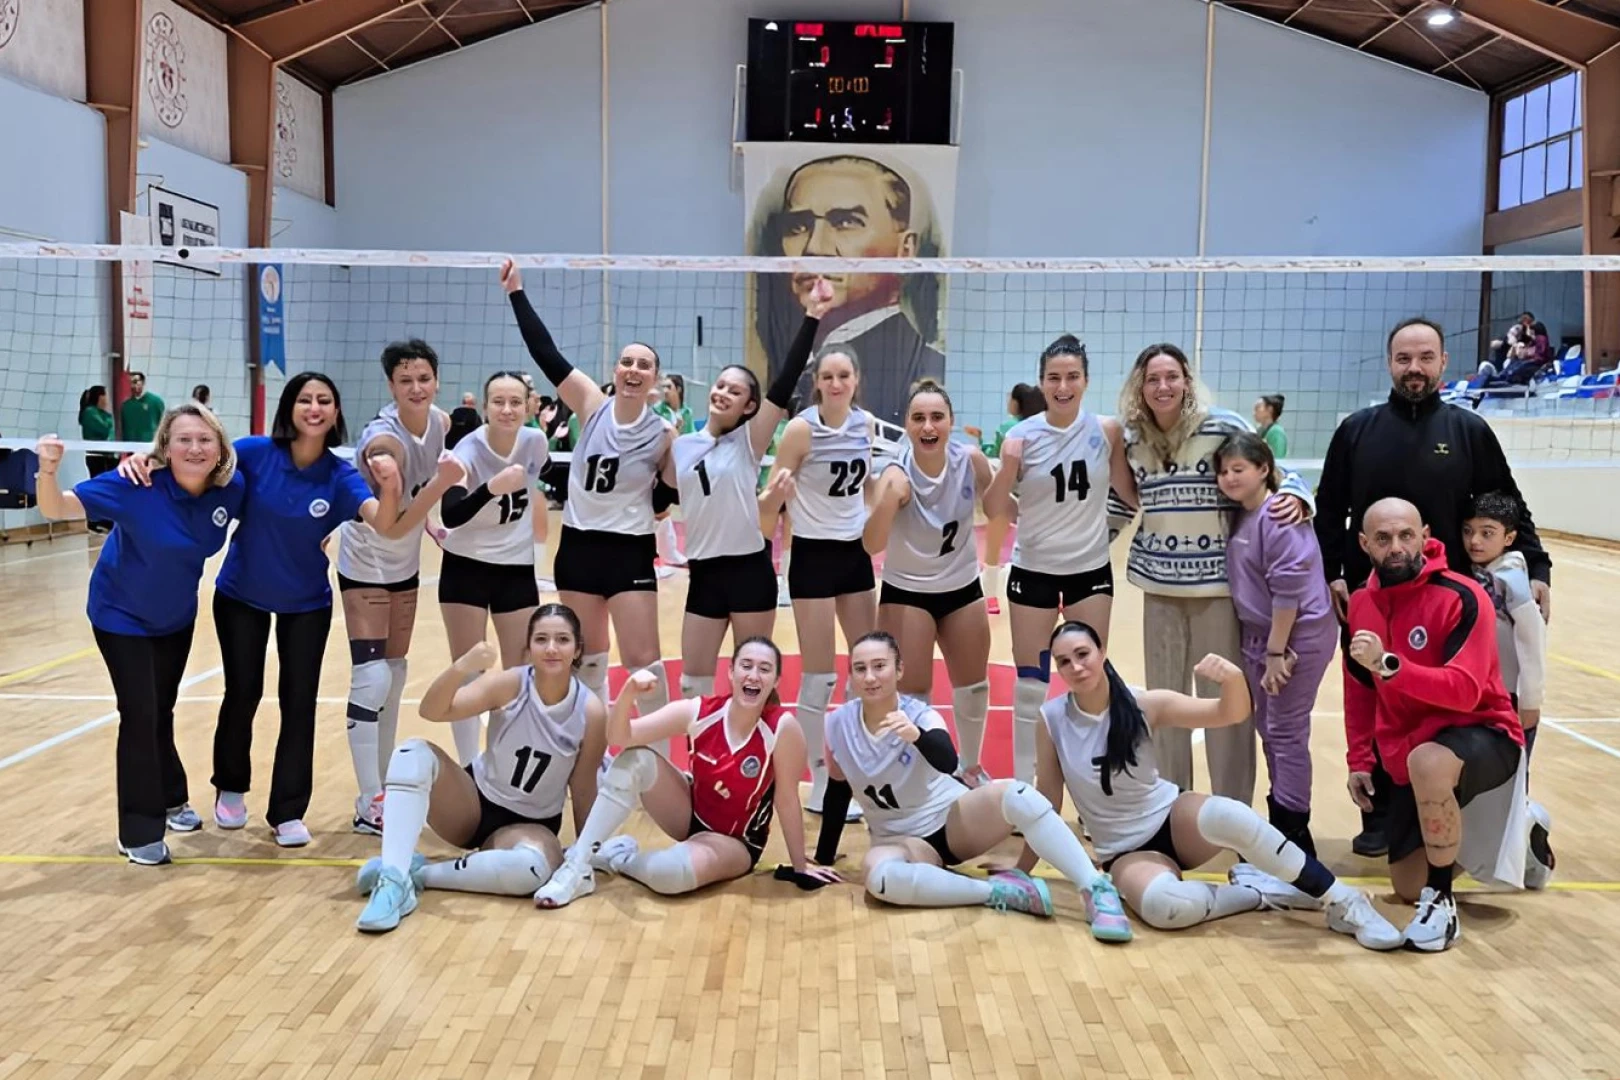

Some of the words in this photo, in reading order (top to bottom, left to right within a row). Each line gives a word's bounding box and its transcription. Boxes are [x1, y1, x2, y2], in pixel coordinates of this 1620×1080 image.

[584, 454, 620, 493] 13
[694, 460, 711, 496] 1
[828, 459, 866, 497] 22
[1051, 459, 1091, 503] 14
[498, 488, 529, 524] 15
[939, 520, 959, 557] 2
[510, 745, 552, 794] 17
[864, 783, 900, 809] 11
